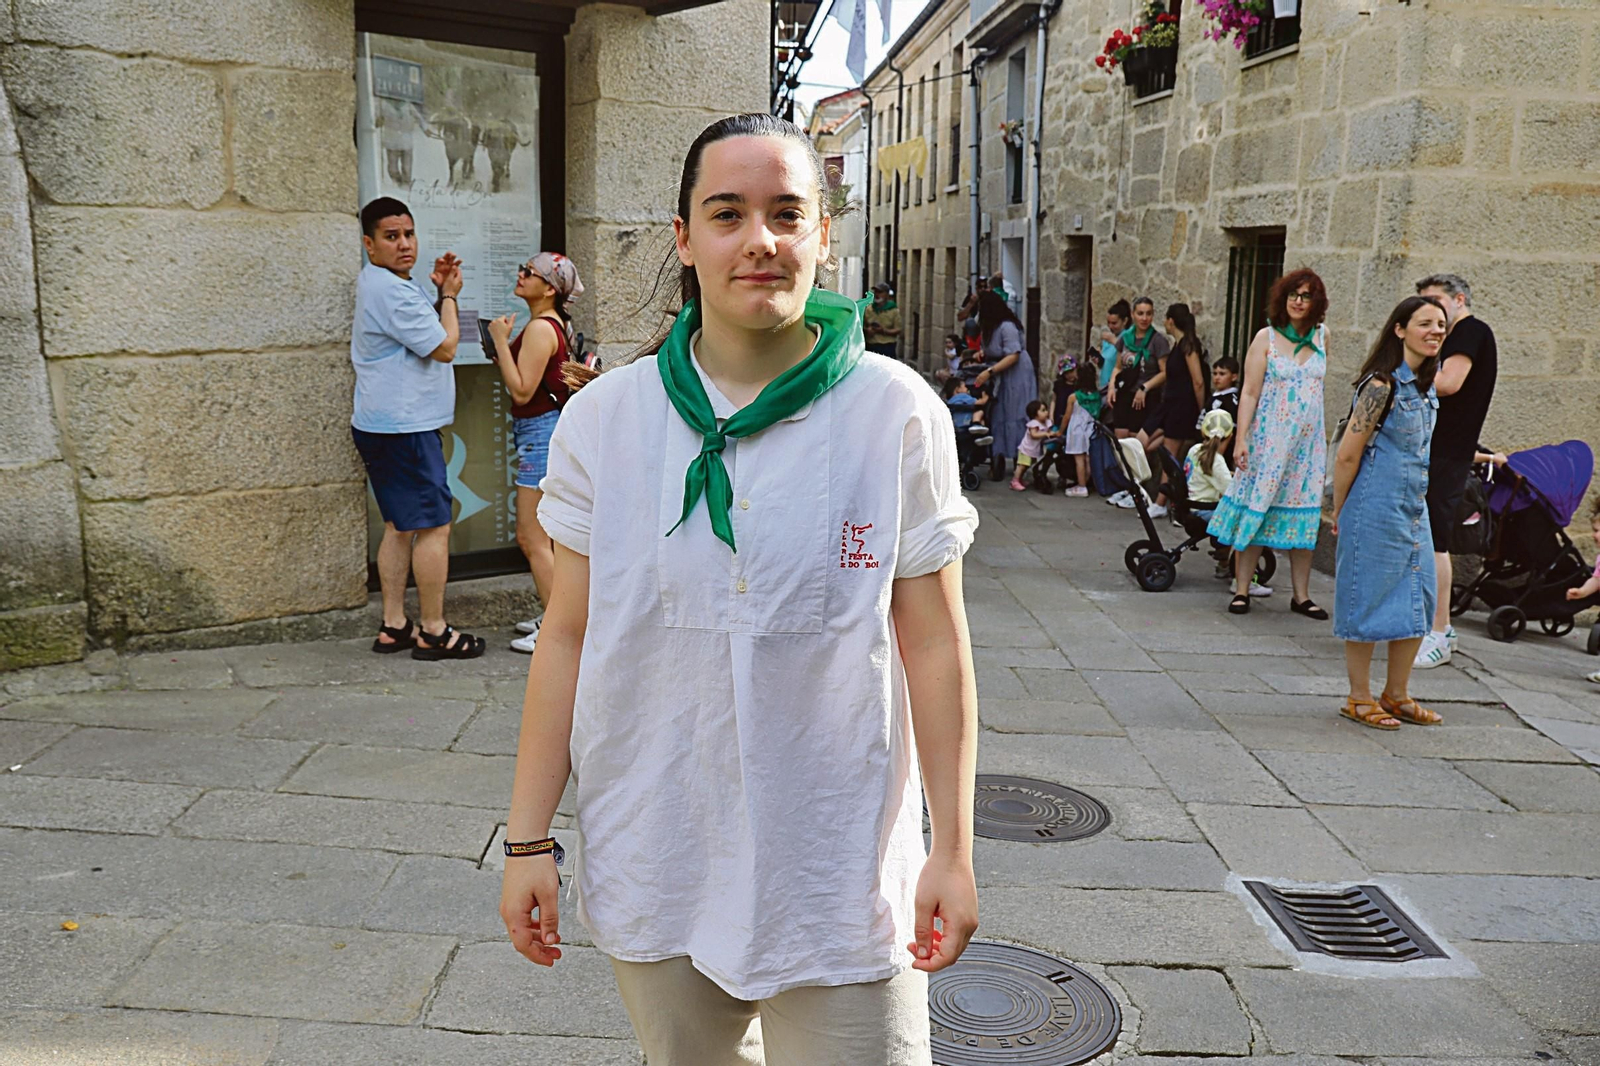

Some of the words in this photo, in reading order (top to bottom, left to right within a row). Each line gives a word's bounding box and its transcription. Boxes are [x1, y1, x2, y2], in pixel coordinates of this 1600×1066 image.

[493, 381, 501, 418] FESTA
[494, 427, 502, 442] DO
[494, 451, 502, 471] BOI
[495, 493, 503, 542] ALLARIZ
[514, 843, 551, 852] NACIONAL
[1039, 997, 1072, 1038] LLAVE
[930, 1026, 980, 1047] PAS
[997, 1035, 1036, 1049] DE
